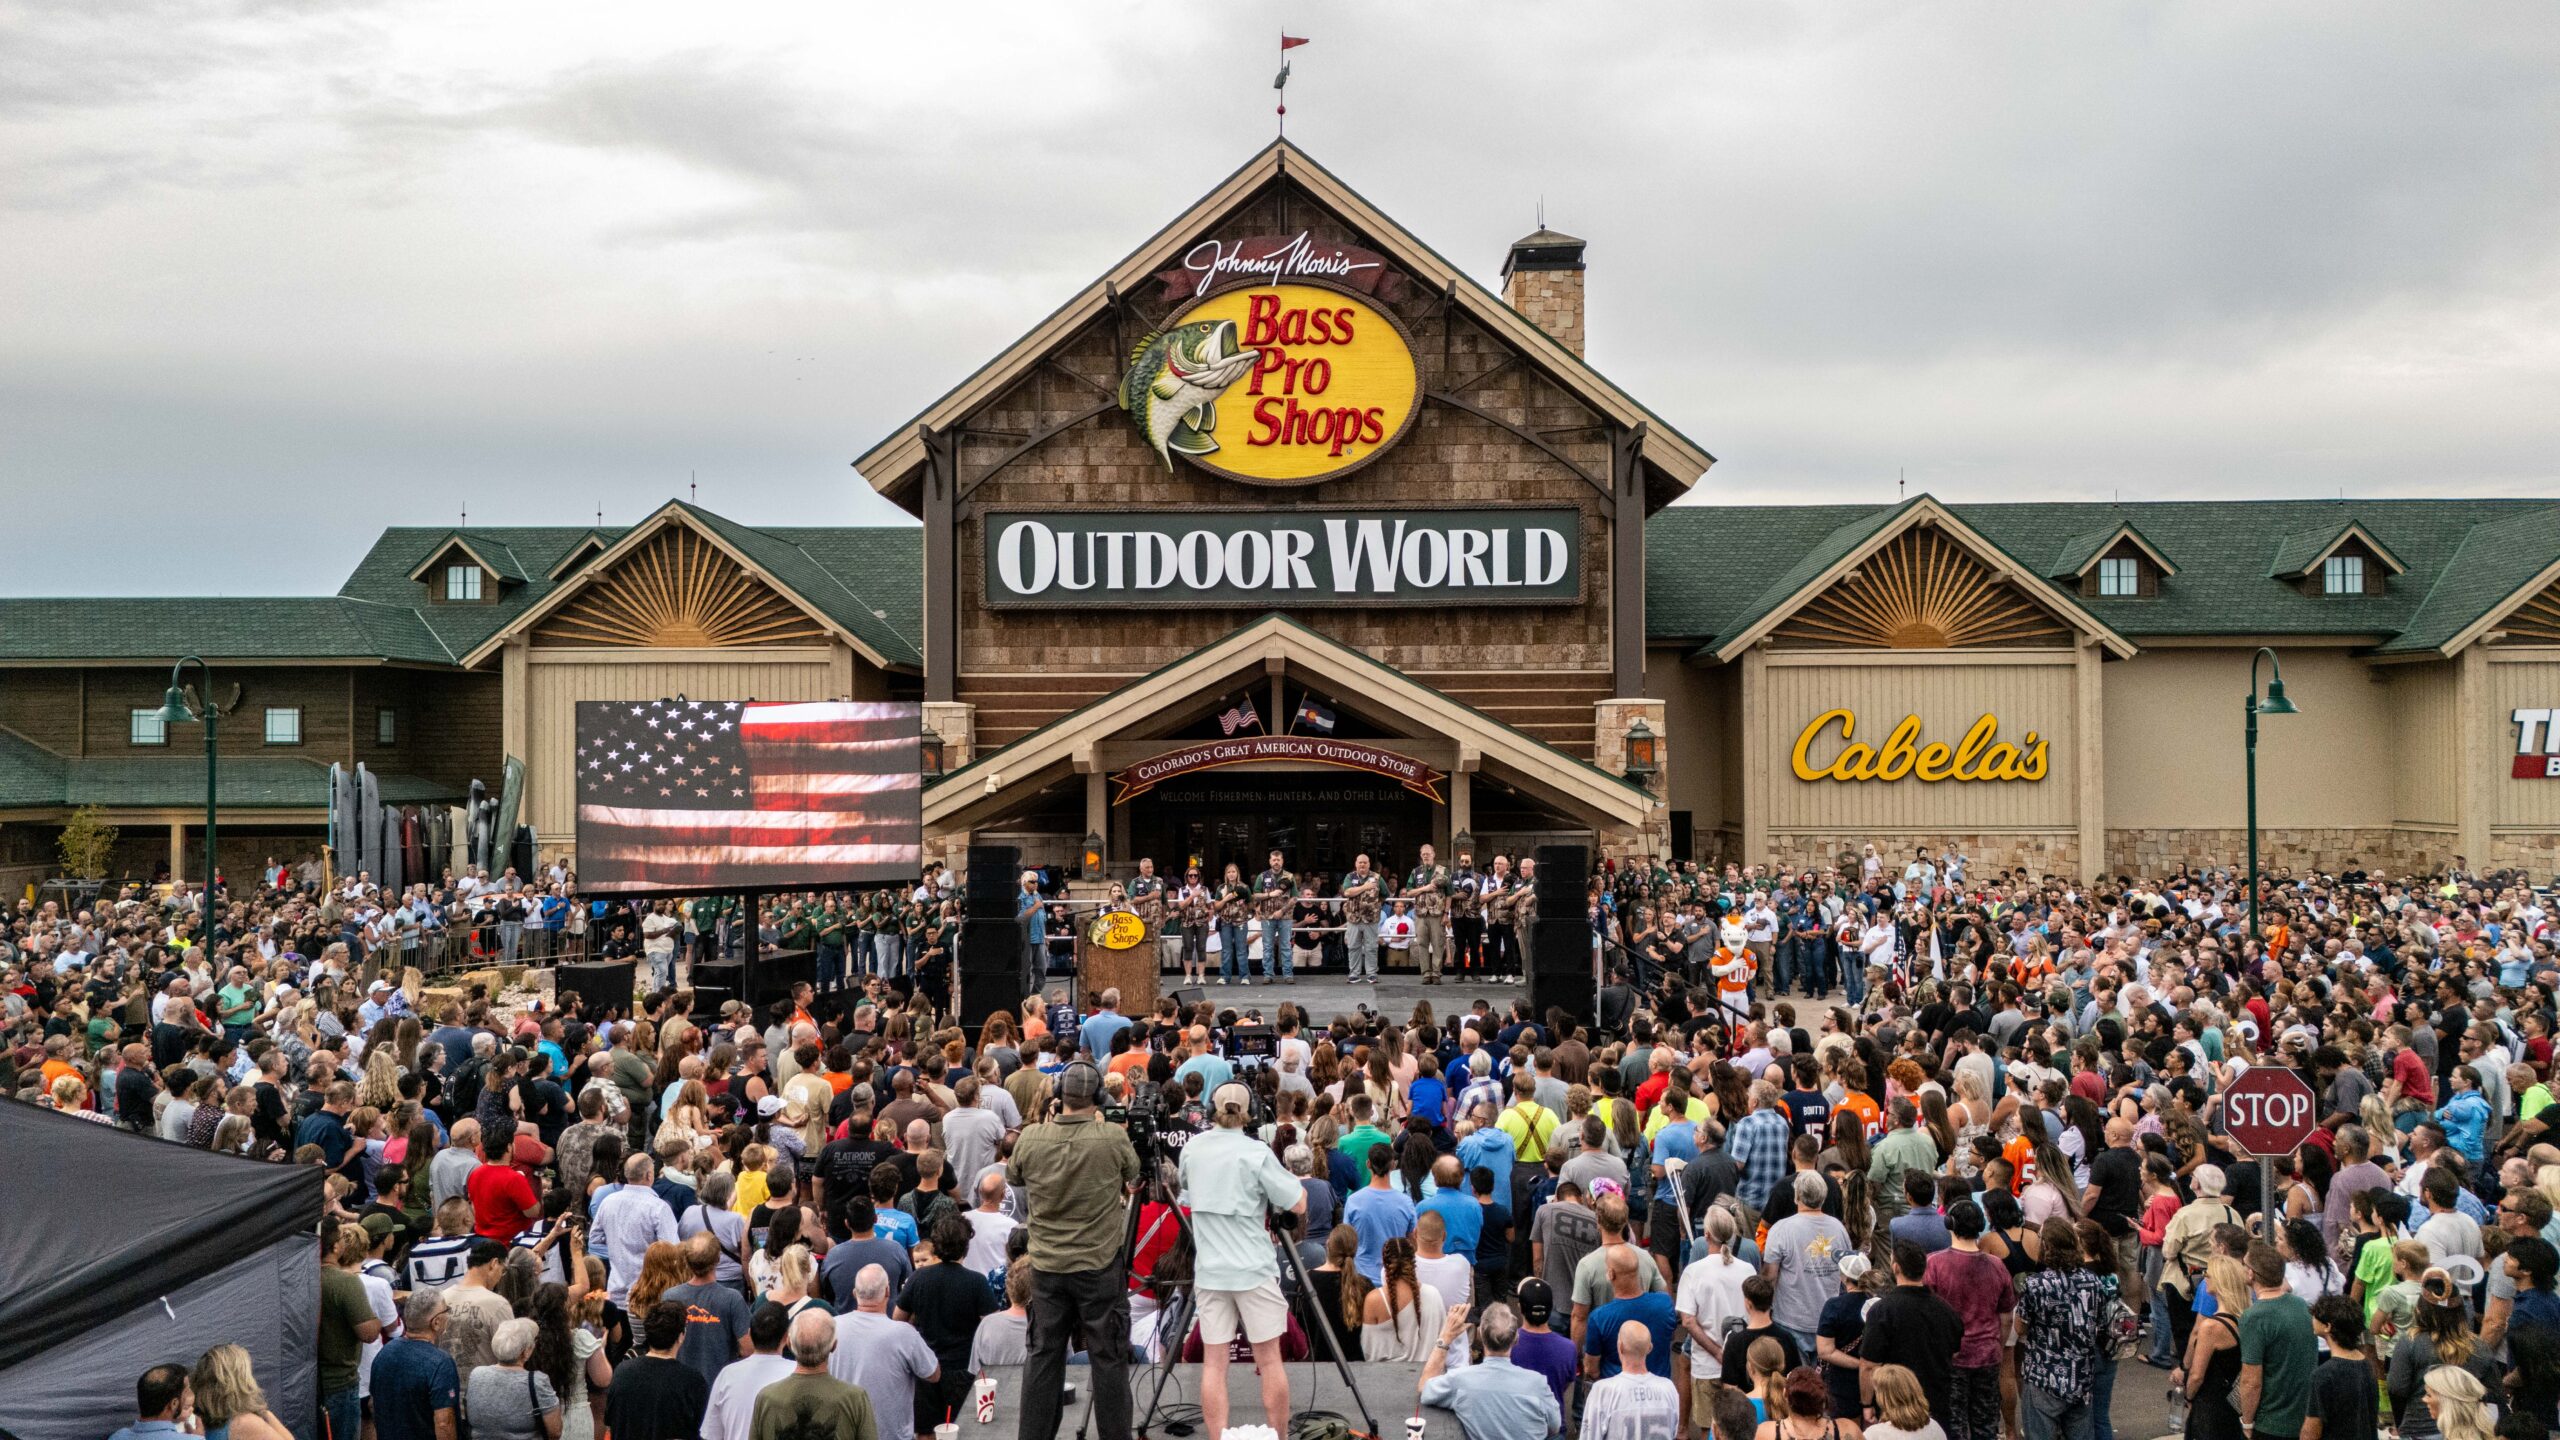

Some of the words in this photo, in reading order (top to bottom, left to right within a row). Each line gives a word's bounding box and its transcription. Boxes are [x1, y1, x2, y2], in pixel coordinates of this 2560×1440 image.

[1184, 240, 1283, 296] Johnny
[1263, 230, 1379, 276] Morris
[1240, 294, 1355, 346] Bass
[1246, 347, 1332, 396] Pro
[1247, 396, 1384, 457] Shops
[997, 520, 1317, 594] OUTDOOR
[1323, 519, 1569, 593] WORLD
[1138, 750, 1211, 779] COLORADO'S
[1214, 745, 1250, 759] GREAT
[1254, 742, 1312, 754] AMERICAN
[1317, 744, 1377, 764] OUTDOOR
[1379, 755, 1416, 777] STORE
[1791, 708, 2049, 782] Cabela's
[1112, 914, 1133, 924] Bass
[1112, 924, 1129, 933] Pro
[1112, 934, 1139, 944] Shops
[2230, 1093, 2309, 1127] STOP
